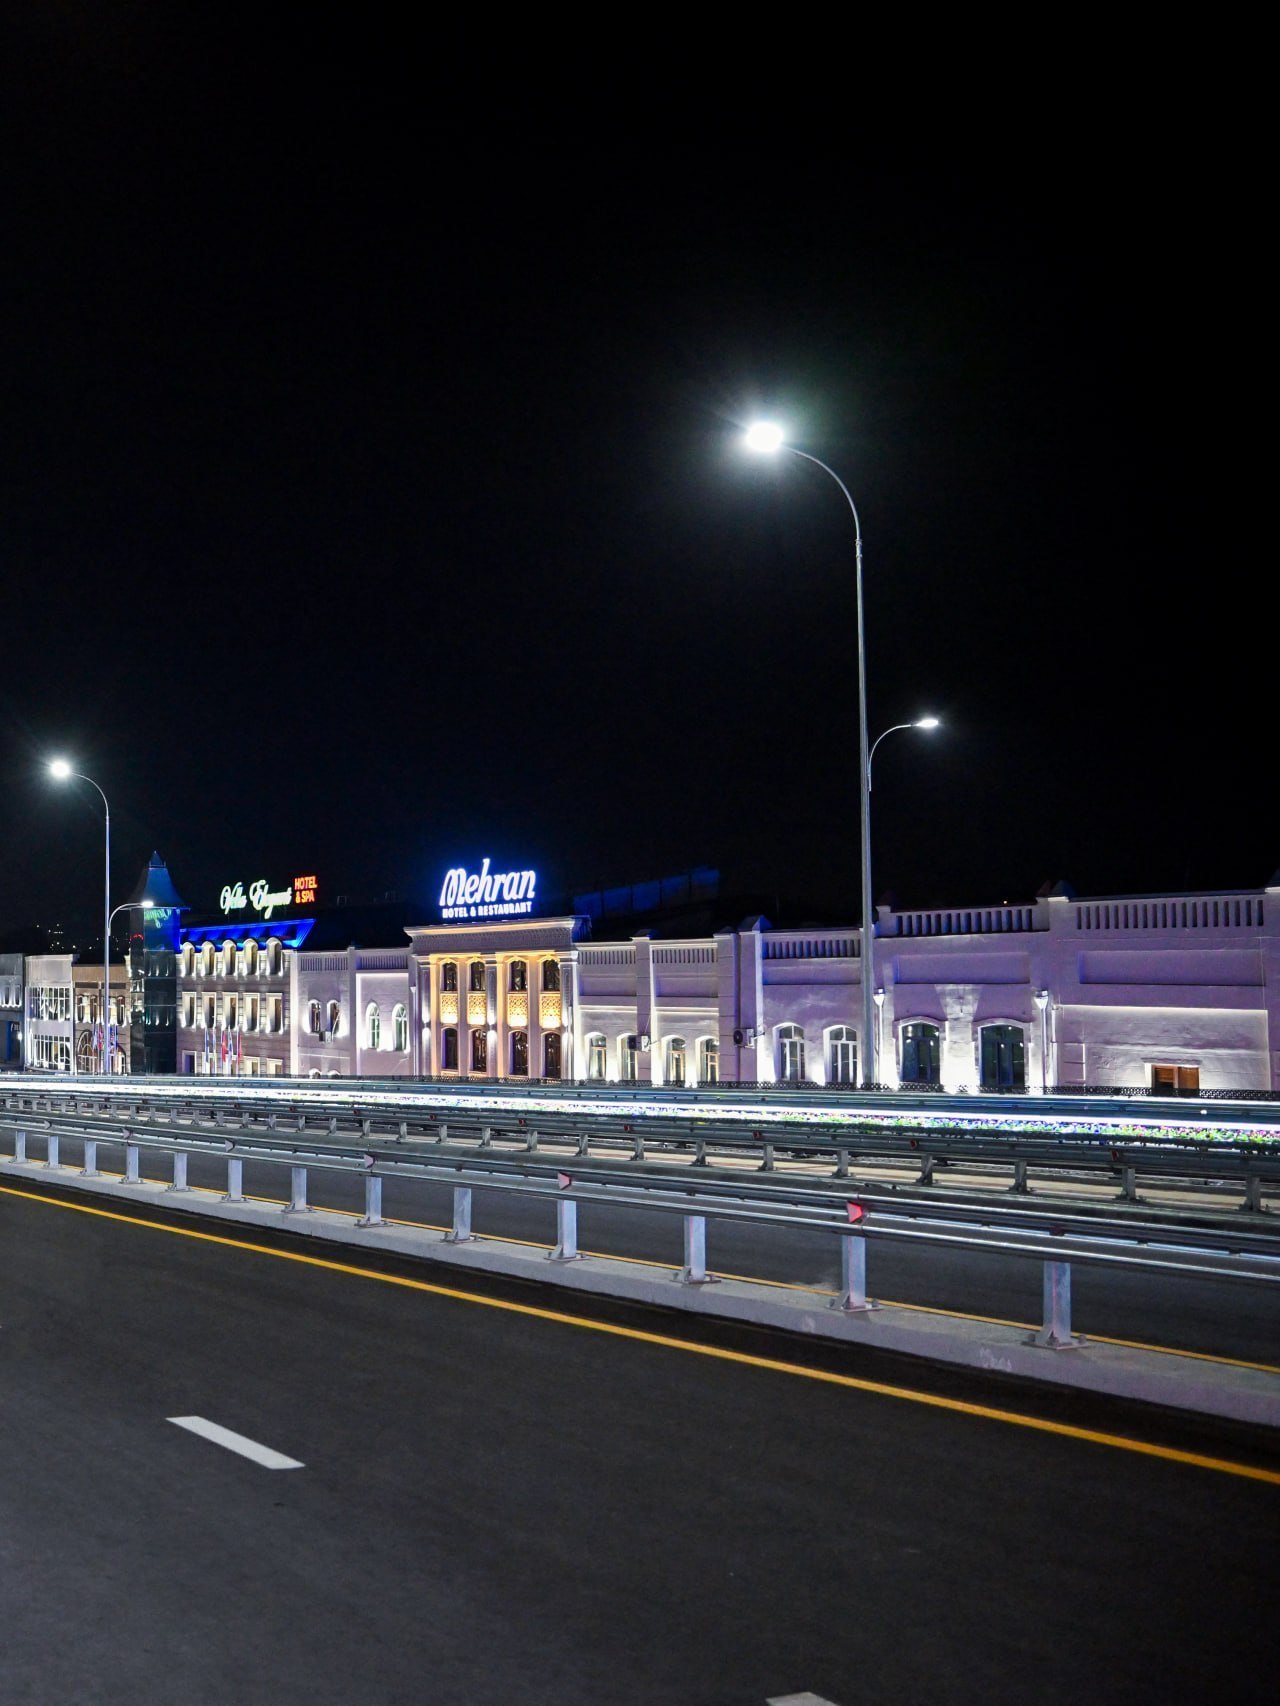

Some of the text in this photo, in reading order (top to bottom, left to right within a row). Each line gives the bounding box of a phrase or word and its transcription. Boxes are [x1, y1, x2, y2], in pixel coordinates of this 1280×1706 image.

[294, 876, 317, 890] HOTEL
[439, 858, 536, 906] Mehran
[301, 890, 315, 903] SPA
[442, 907, 468, 918] HOTEL
[478, 901, 532, 916] RESTAURANT
